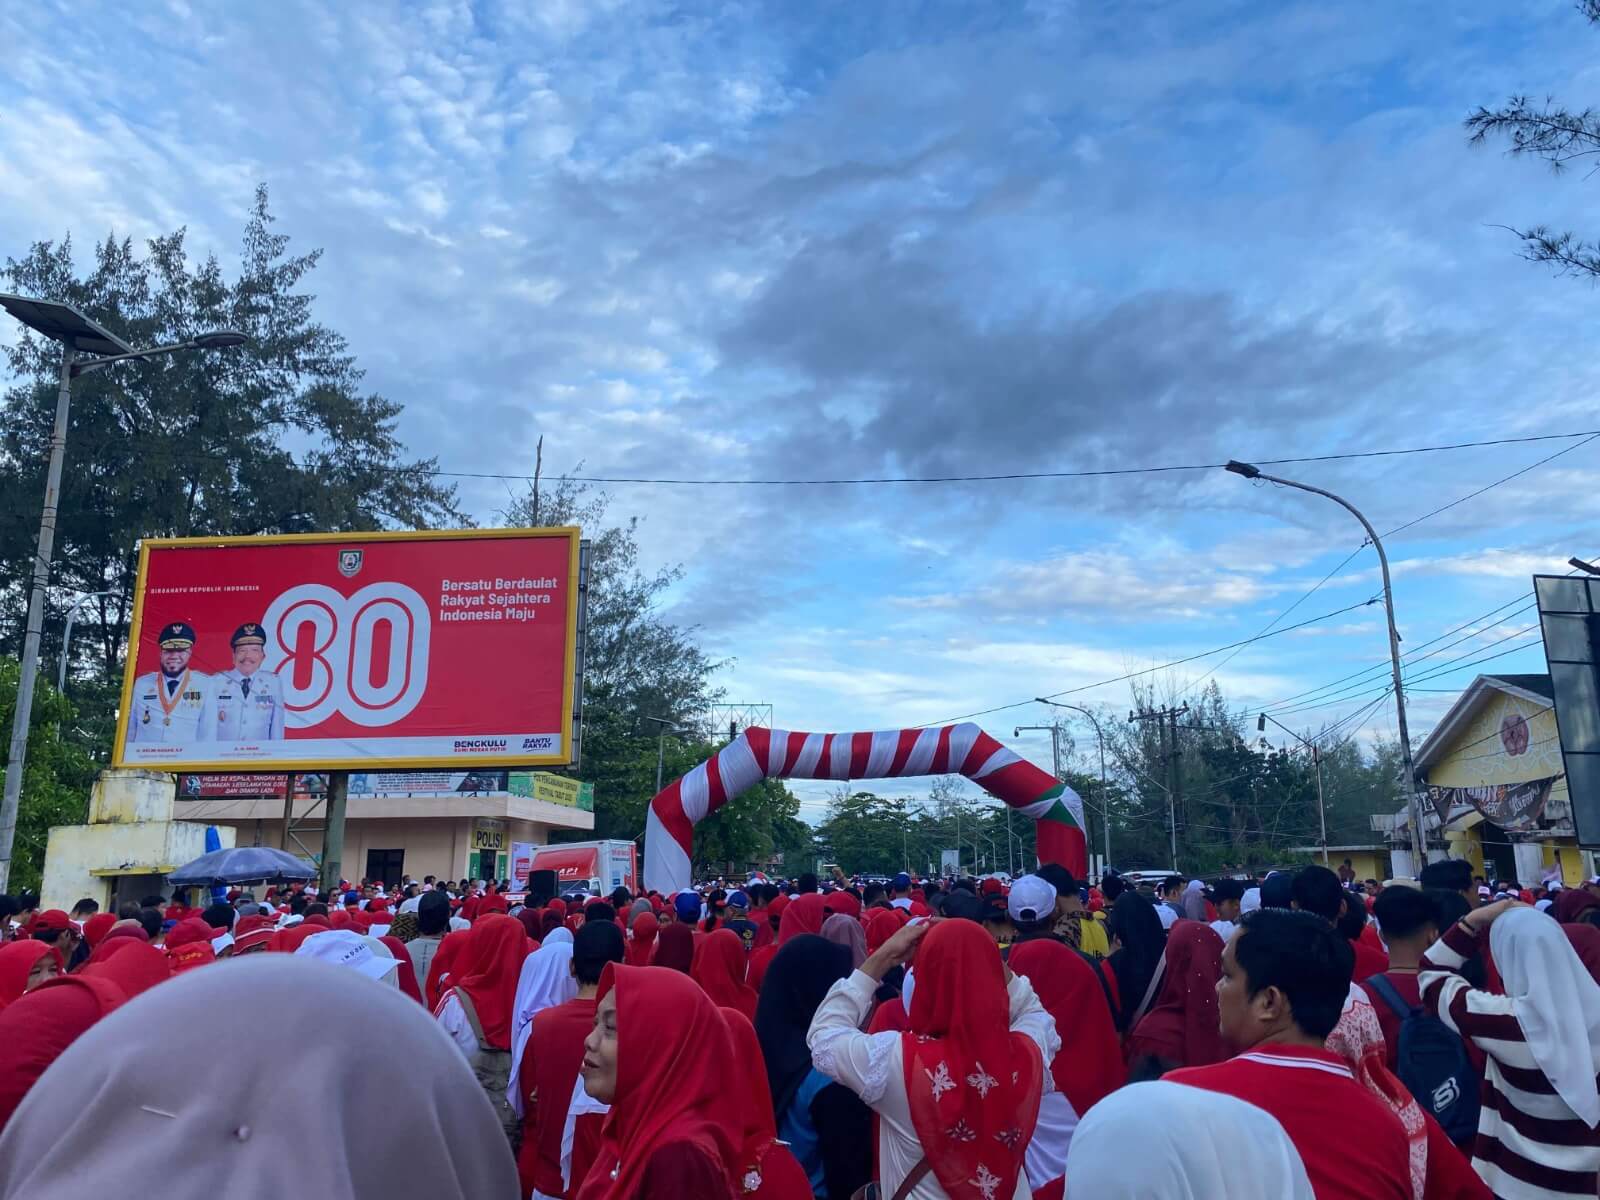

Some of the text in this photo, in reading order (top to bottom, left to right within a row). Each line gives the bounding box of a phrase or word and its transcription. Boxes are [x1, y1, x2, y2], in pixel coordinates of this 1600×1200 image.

[442, 577, 557, 592] Bersatu Berdaulat
[441, 592, 551, 608] Rakyat Sejahtera
[440, 607, 536, 621] Indonesia Maju
[260, 582, 431, 728] 80
[454, 740, 507, 748] BENGKULU
[476, 831, 503, 848] POLISI
